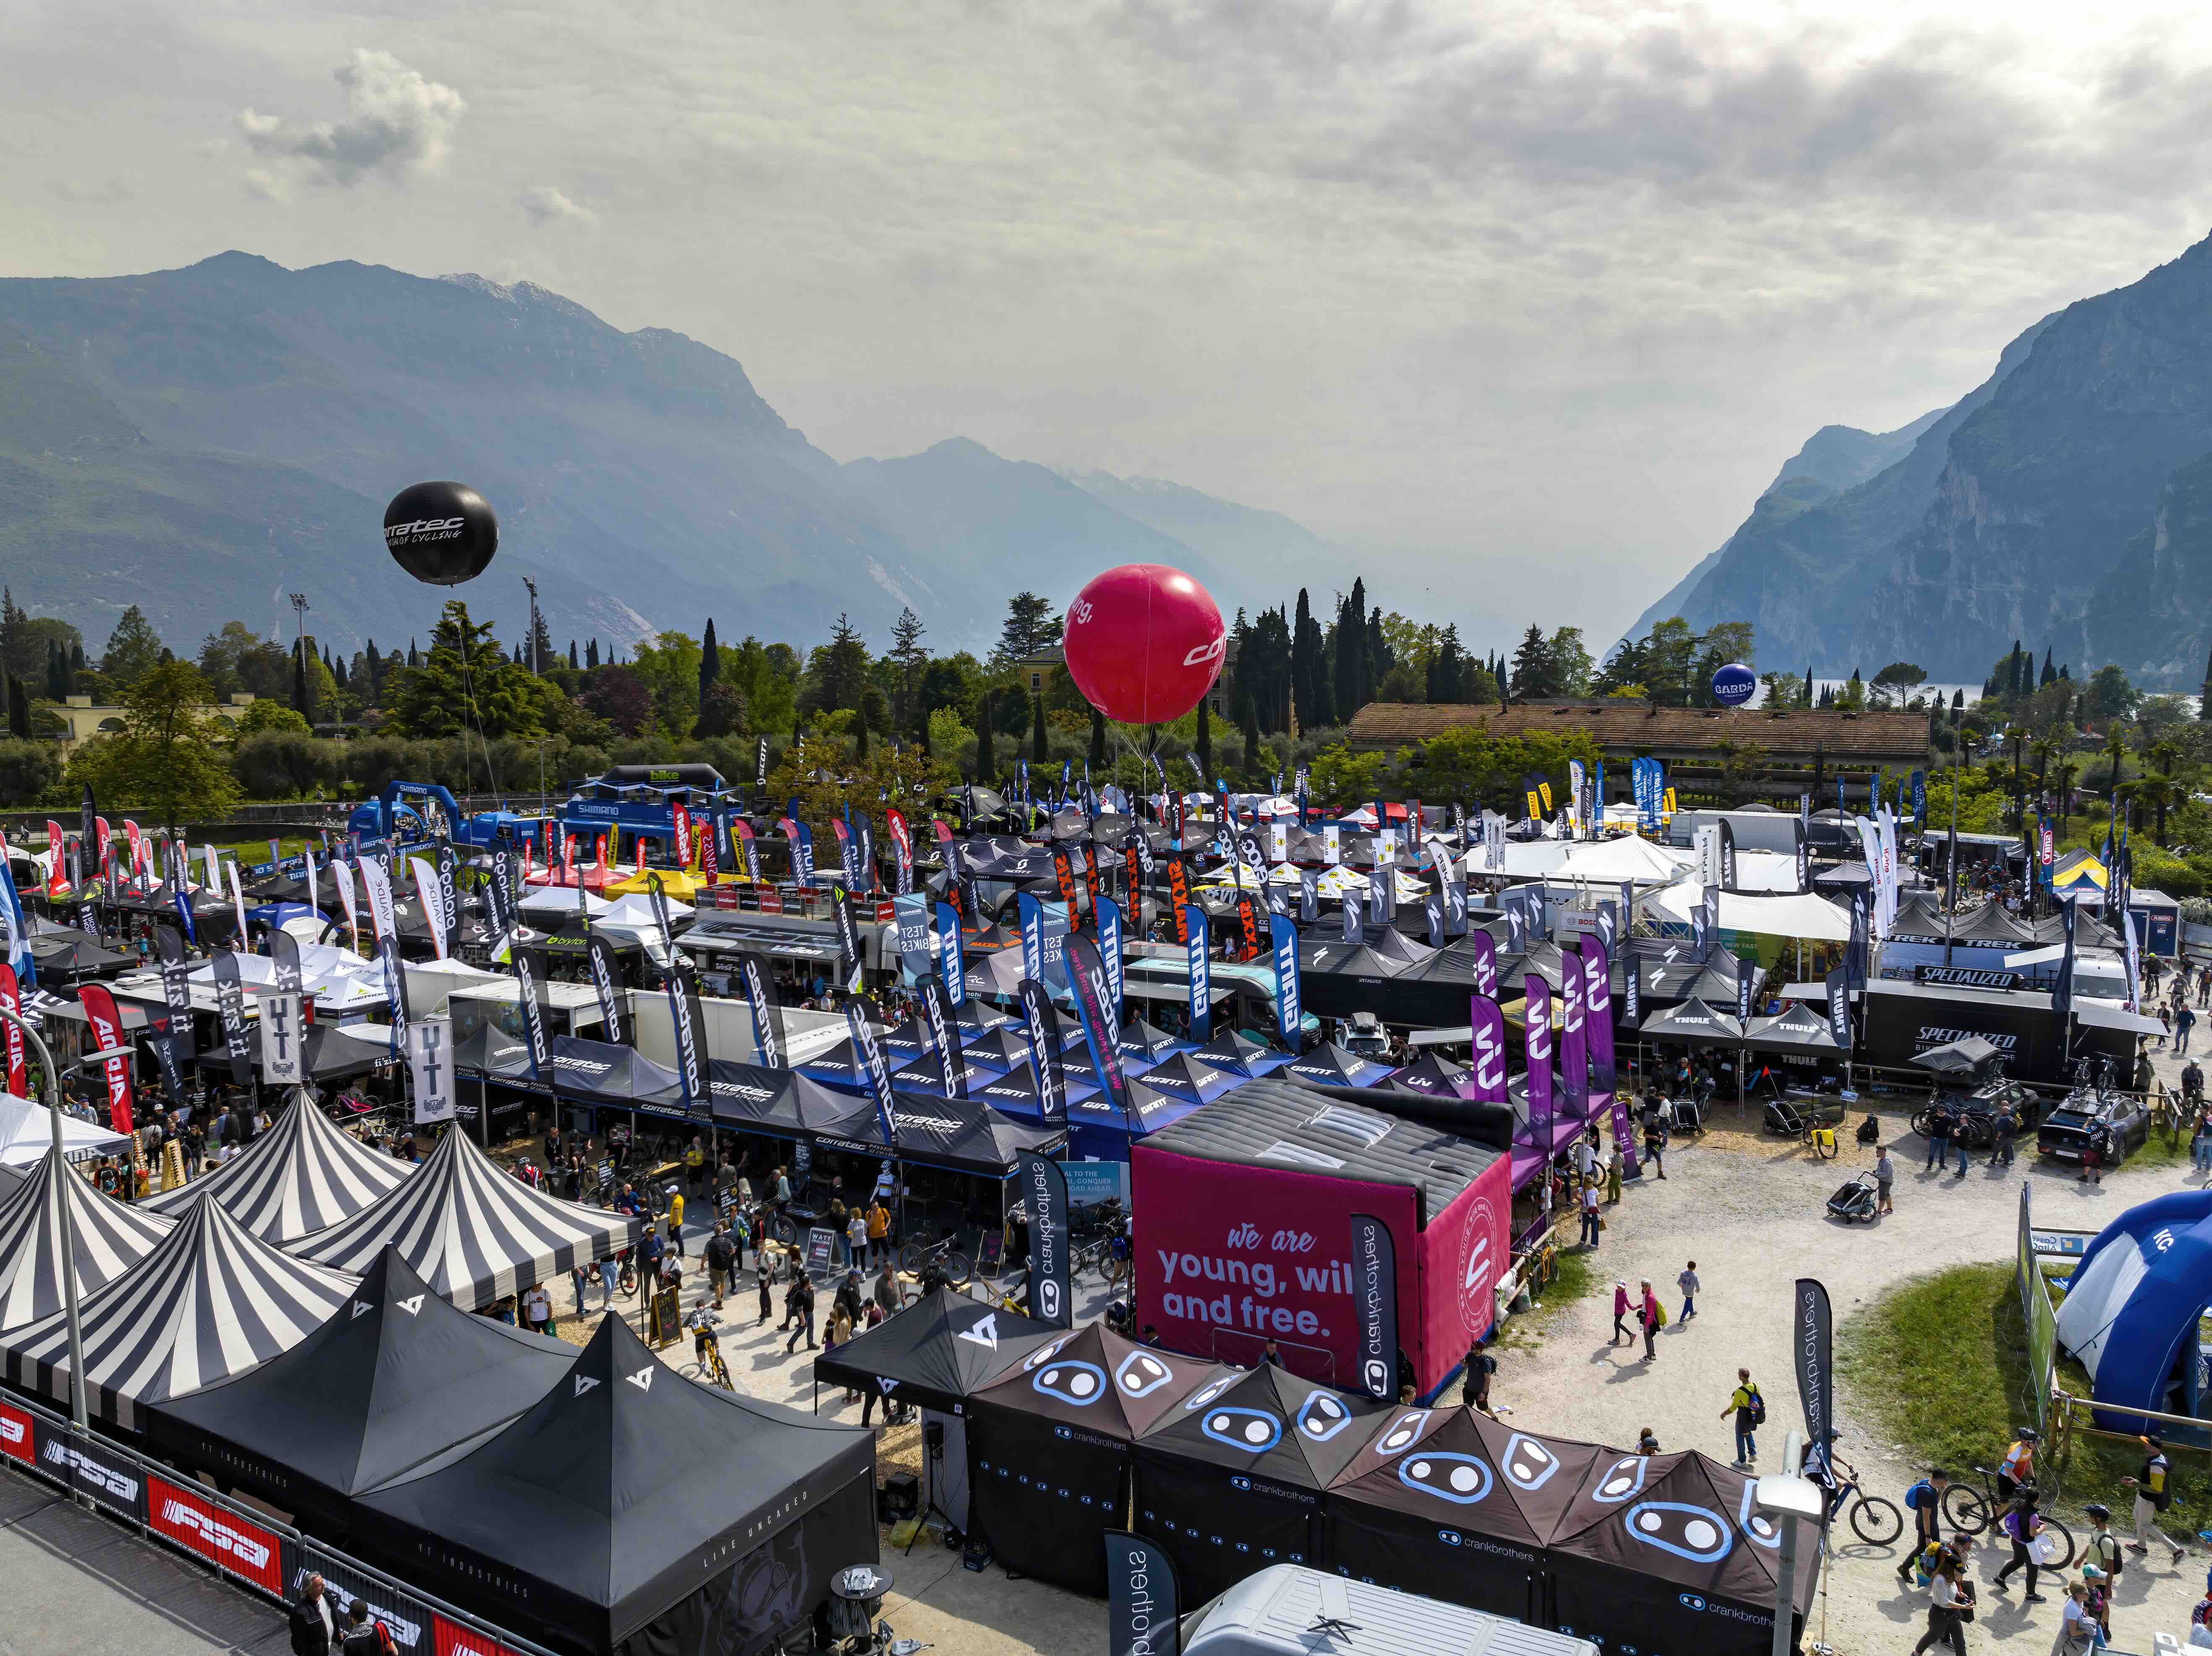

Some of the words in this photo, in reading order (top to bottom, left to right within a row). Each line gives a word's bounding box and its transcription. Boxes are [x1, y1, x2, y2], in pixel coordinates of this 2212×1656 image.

[383, 517, 464, 538] orratec
[412, 530, 462, 543] CYCLING
[1715, 682, 1753, 694] GARDA
[650, 771, 680, 780] bike
[399, 785, 427, 794] SHIMANO
[579, 805, 618, 815] SHIMANO
[558, 937, 587, 945] bryton
[1964, 940, 2022, 949] TREK
[1921, 968, 2013, 987] SPECIALIZED
[984, 1016, 1007, 1027] GIANT
[1779, 1023, 1816, 1033] THULE
[1917, 1027, 2016, 1048] SPECIAIZED
[1153, 1038, 1174, 1050] GIANT
[962, 1050, 1001, 1059] GIANT
[1009, 1048, 1033, 1060] GIANT
[1245, 1050, 1266, 1062] GIANT
[1782, 1054, 1818, 1066] THULE
[809, 1061, 848, 1070] GIANT
[1289, 1066, 1337, 1075] GIANT
[490, 1076, 529, 1088] corratec
[895, 1073, 937, 1083] GIANT
[1141, 1075, 1187, 1086] GIANT
[1197, 1072, 1218, 1087] GIANT
[1408, 1076, 1432, 1087] Liv
[1454, 1074, 1468, 1084] Liv
[985, 1087, 1031, 1097] GIANT
[642, 1104, 686, 1116] corratec
[1141, 1097, 1166, 1114] GIANT
[816, 1137, 866, 1150] corratec
[1227, 1223, 1262, 1250] we
[1272, 1229, 1317, 1252] are
[1158, 1250, 1286, 1297] young,
[1295, 1260, 1353, 1294] wil
[1163, 1292, 1241, 1325] and
[1242, 1297, 1330, 1337] free.
[1074, 1432, 1127, 1451] crankbrothers
[202, 1442, 211, 1451] YT
[222, 1450, 288, 1487] INDUSTRIES
[1253, 1482, 1315, 1504] crankbrothers
[704, 1539, 735, 1567] LIVE
[749, 1491, 806, 1537] UNCAGED
[1465, 1536, 1534, 1562] crankbrothers
[419, 1544, 431, 1556] YT
[443, 1554, 527, 1599] INDUSTRIES
[1709, 1602, 1775, 1627] crankbrothe
